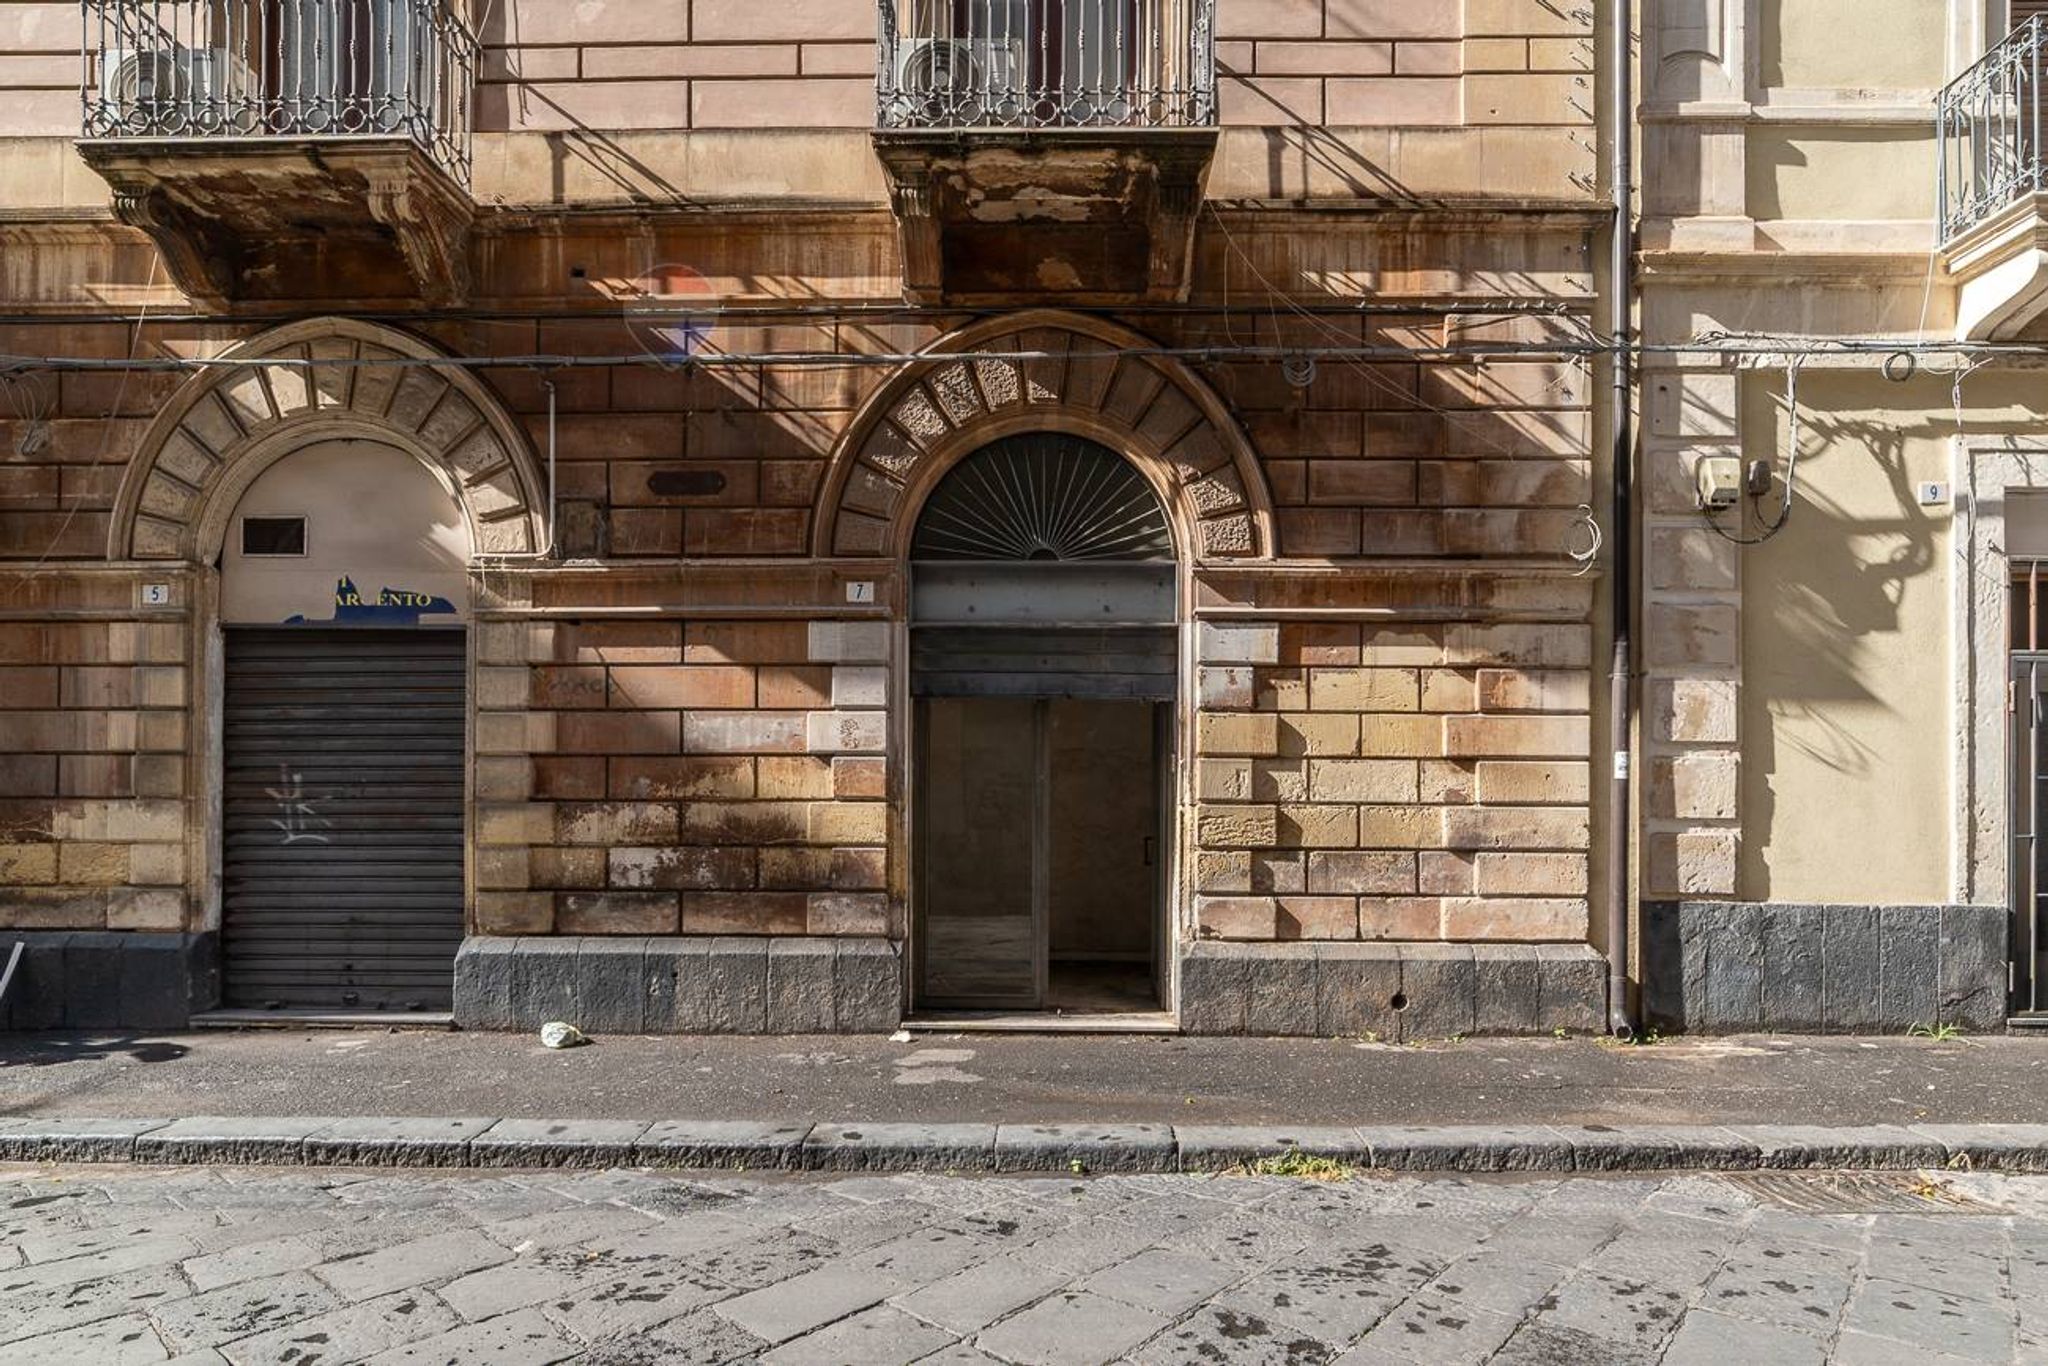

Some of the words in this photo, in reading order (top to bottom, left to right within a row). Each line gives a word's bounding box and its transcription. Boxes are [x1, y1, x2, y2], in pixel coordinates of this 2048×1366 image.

[1930, 485, 1938, 500] 9
[152, 586, 159, 601] 5
[336, 592, 432, 606] ARENTO
[857, 584, 864, 599] 7
